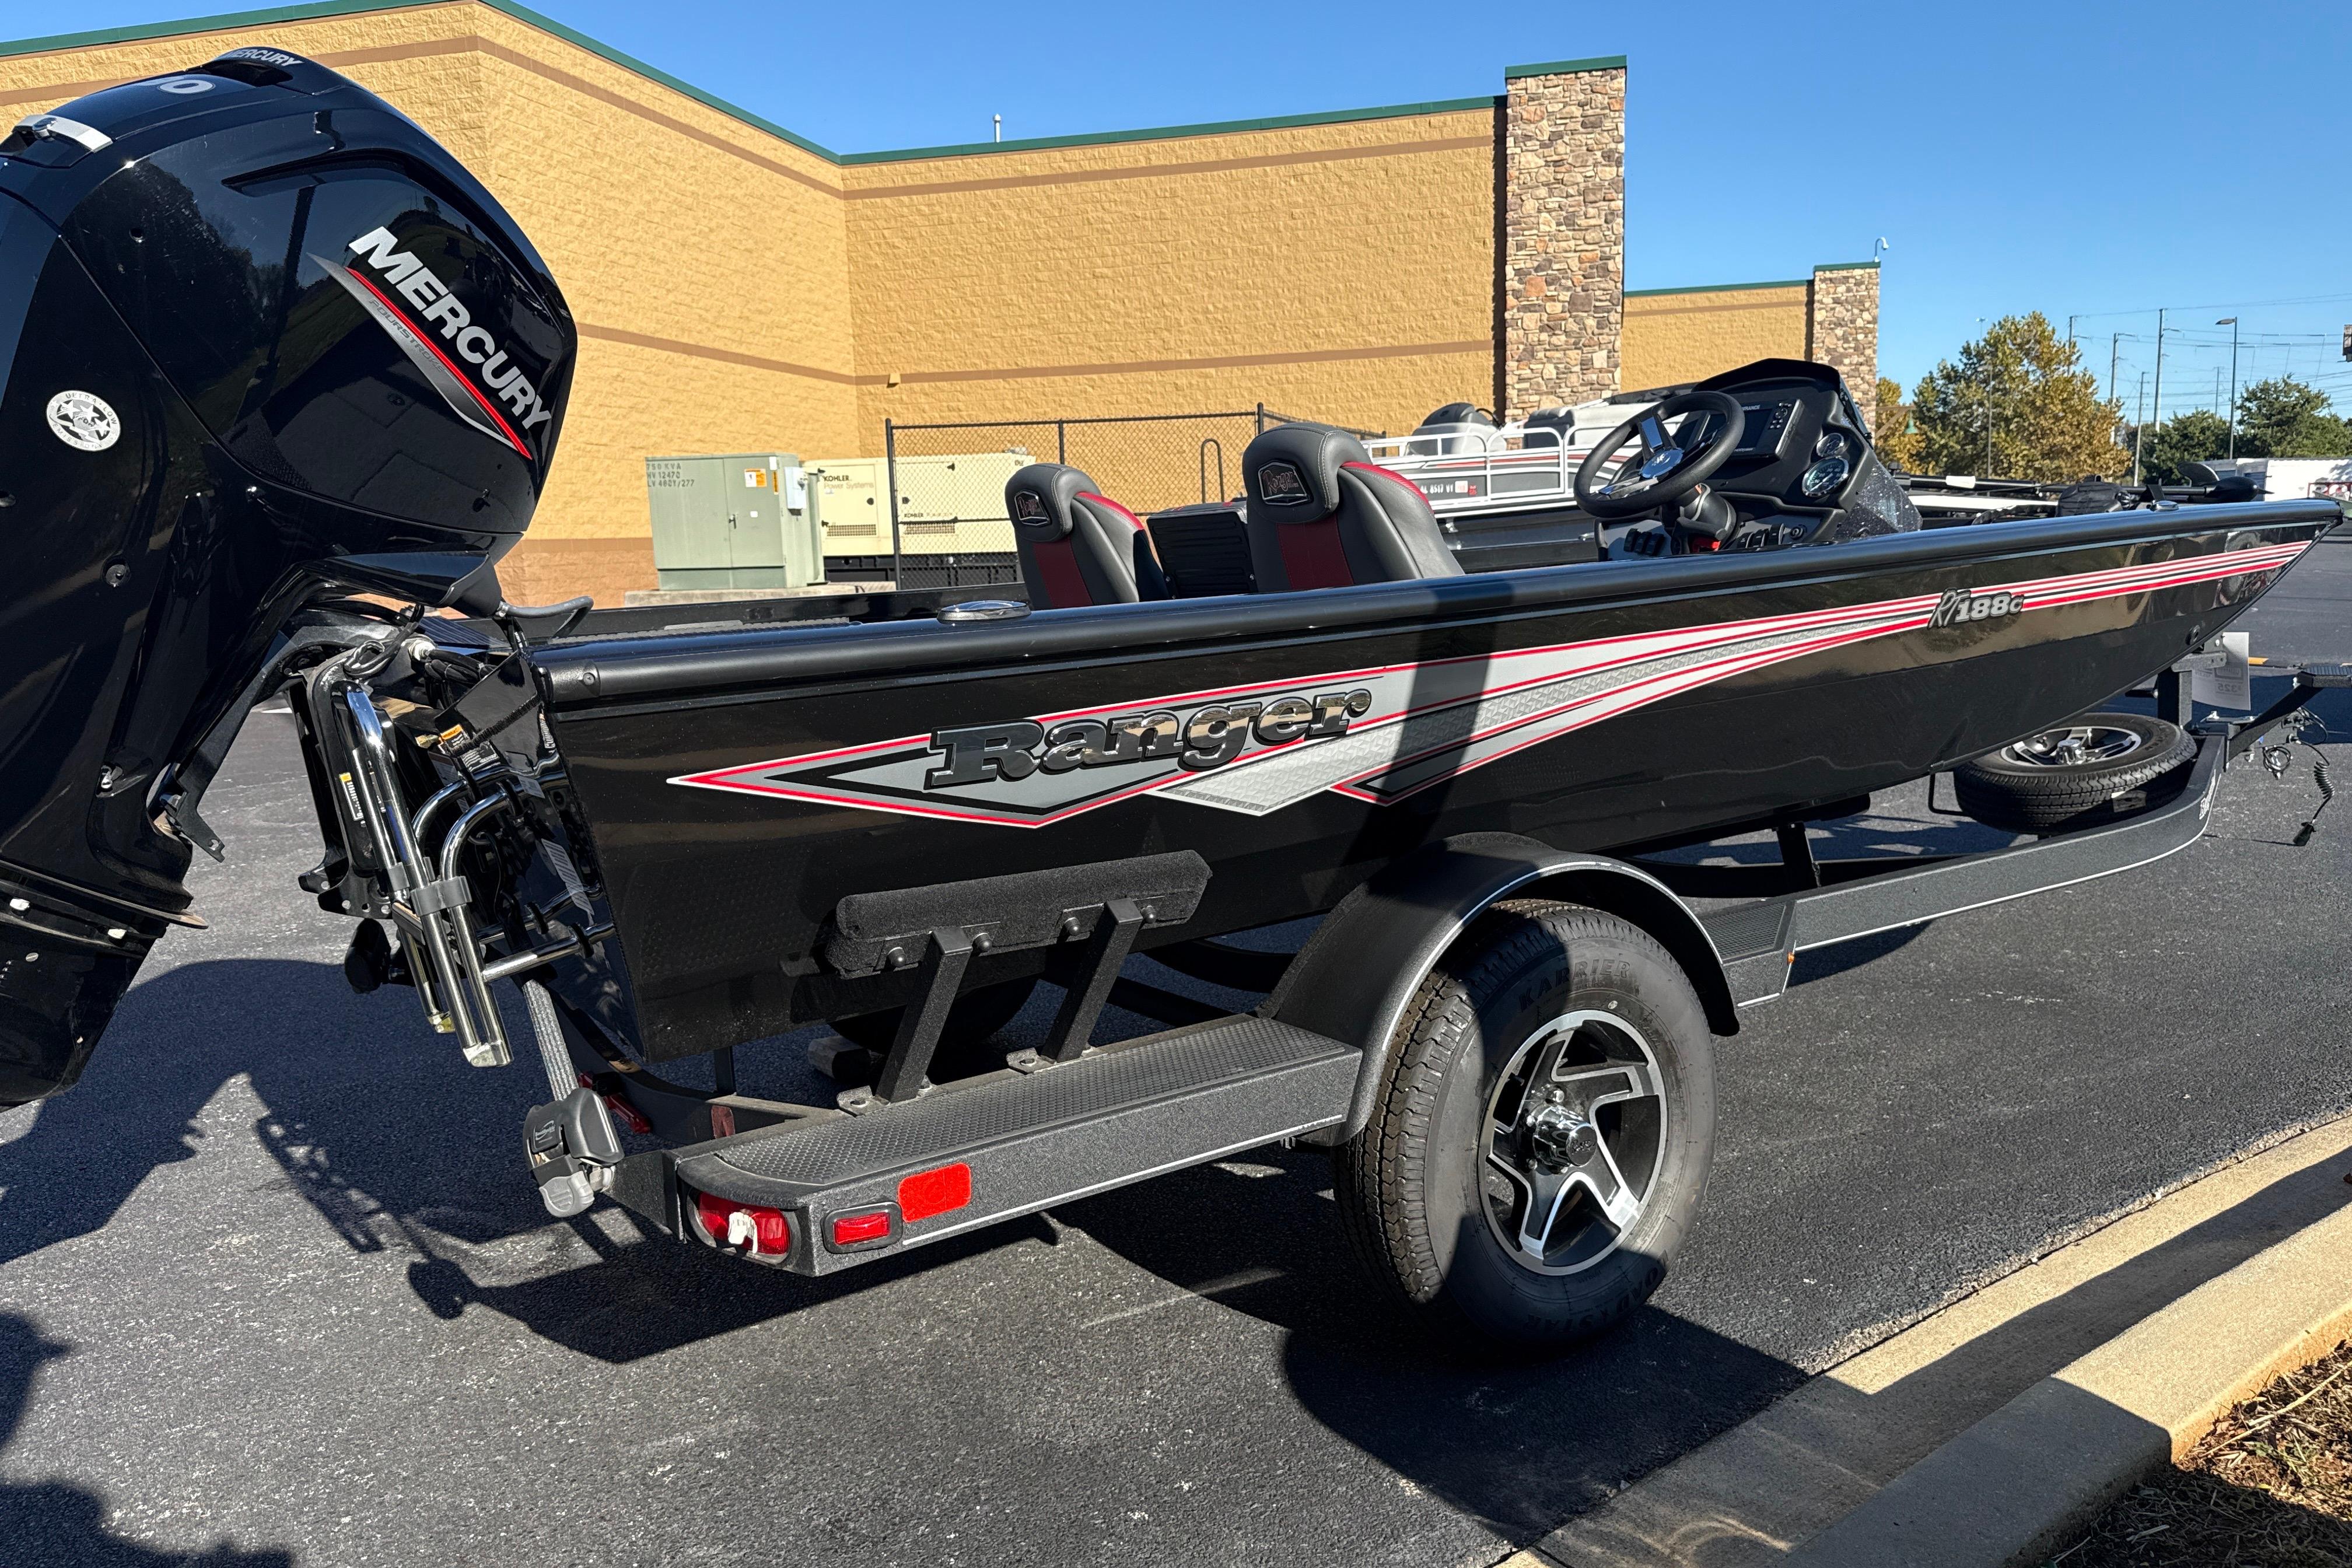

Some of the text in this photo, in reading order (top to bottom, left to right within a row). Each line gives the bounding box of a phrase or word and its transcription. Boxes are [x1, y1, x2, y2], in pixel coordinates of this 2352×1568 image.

[225, 49, 304, 66] MERCURY
[348, 226, 551, 430] MERCURY
[369, 298, 444, 372] FOURSTROKE
[65, 393, 117, 425] ULTRA LOW
[846, 482, 874, 490] Systems
[923, 688, 1373, 788] Ranger
[1518, 959, 1630, 1013] KARRIER
